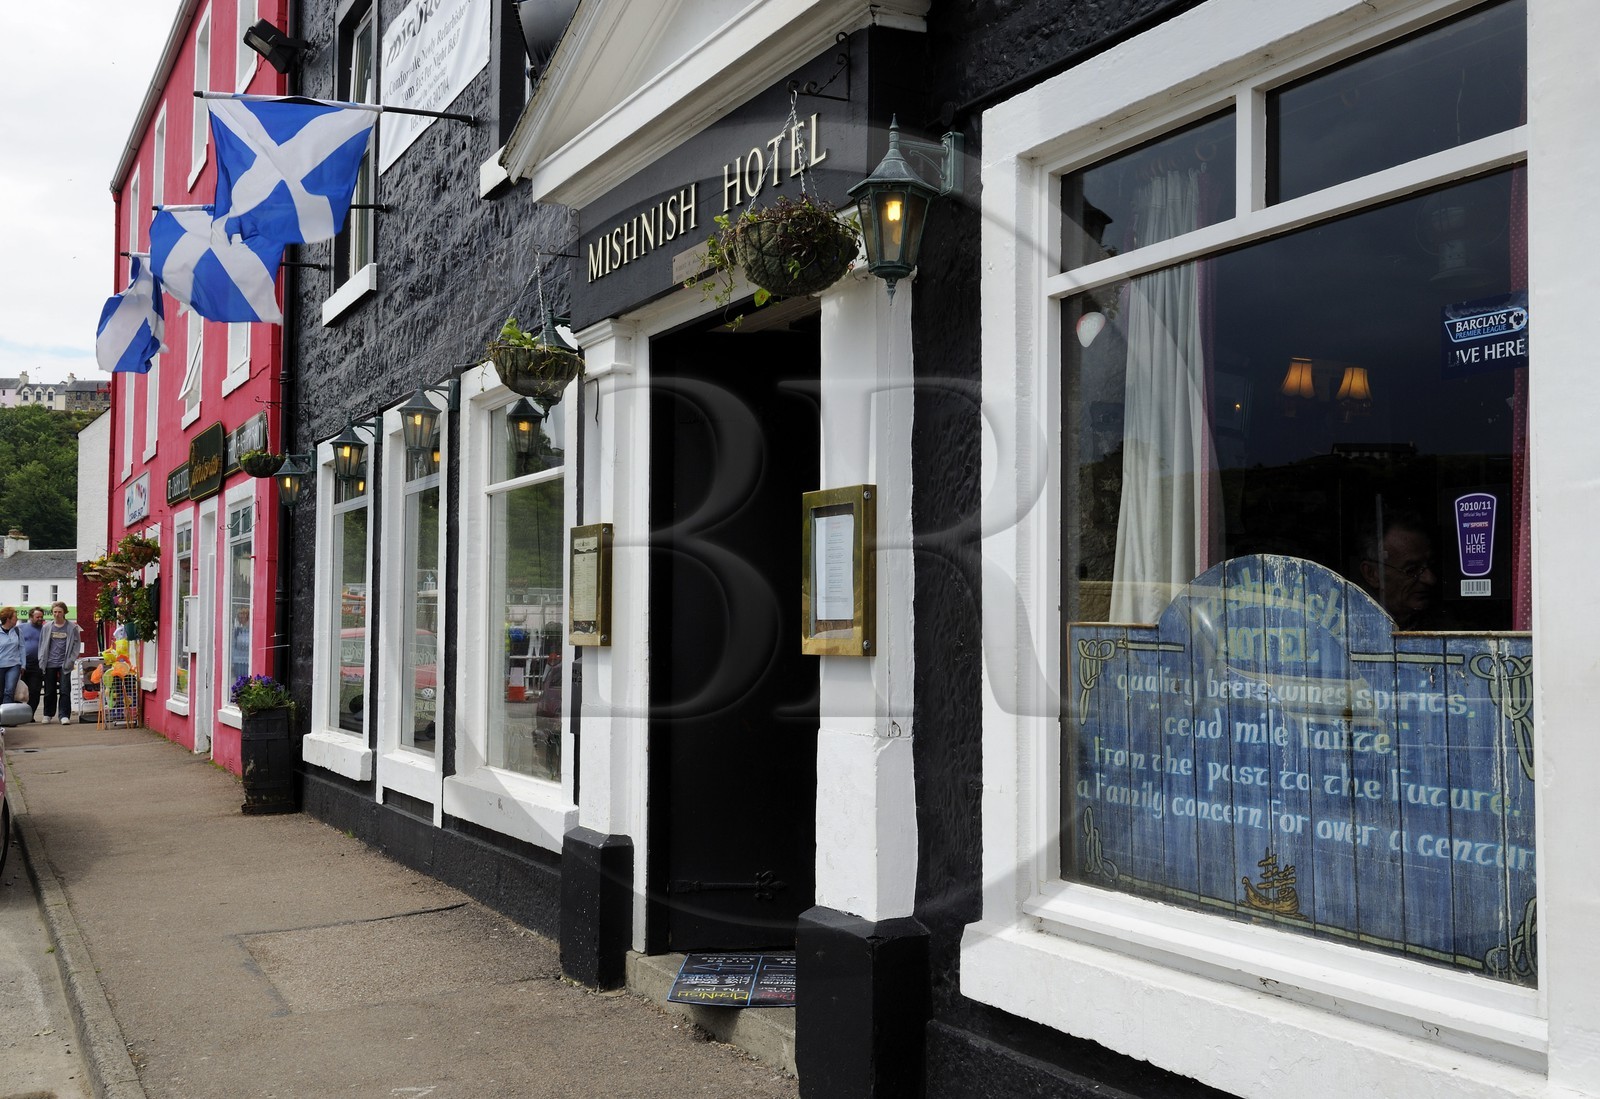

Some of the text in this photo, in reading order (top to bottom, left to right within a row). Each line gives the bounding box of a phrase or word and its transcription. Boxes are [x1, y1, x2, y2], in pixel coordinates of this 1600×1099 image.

[588, 112, 827, 283] MISHNISH HOTEL
[1455, 313, 1507, 333] BARCLAYS
[1455, 324, 1507, 340] PREMIER LEAGUE
[1485, 339, 1526, 361] HERE
[1460, 501, 1491, 511] 2010/11
[1466, 533, 1486, 545] LIVE
[1466, 544, 1486, 554] HERE
[1217, 626, 1320, 663] HOTEL
[1235, 709, 1289, 746] mile
[1152, 745, 1193, 775] the
[1207, 761, 1269, 791] past
[1280, 770, 1312, 790] to
[1323, 763, 1382, 800] the
[1077, 780, 1091, 799] a
[1172, 797, 1264, 830] concern
[1316, 819, 1379, 846] over
[1389, 830, 1409, 852] a
[1418, 833, 1535, 871] centur
